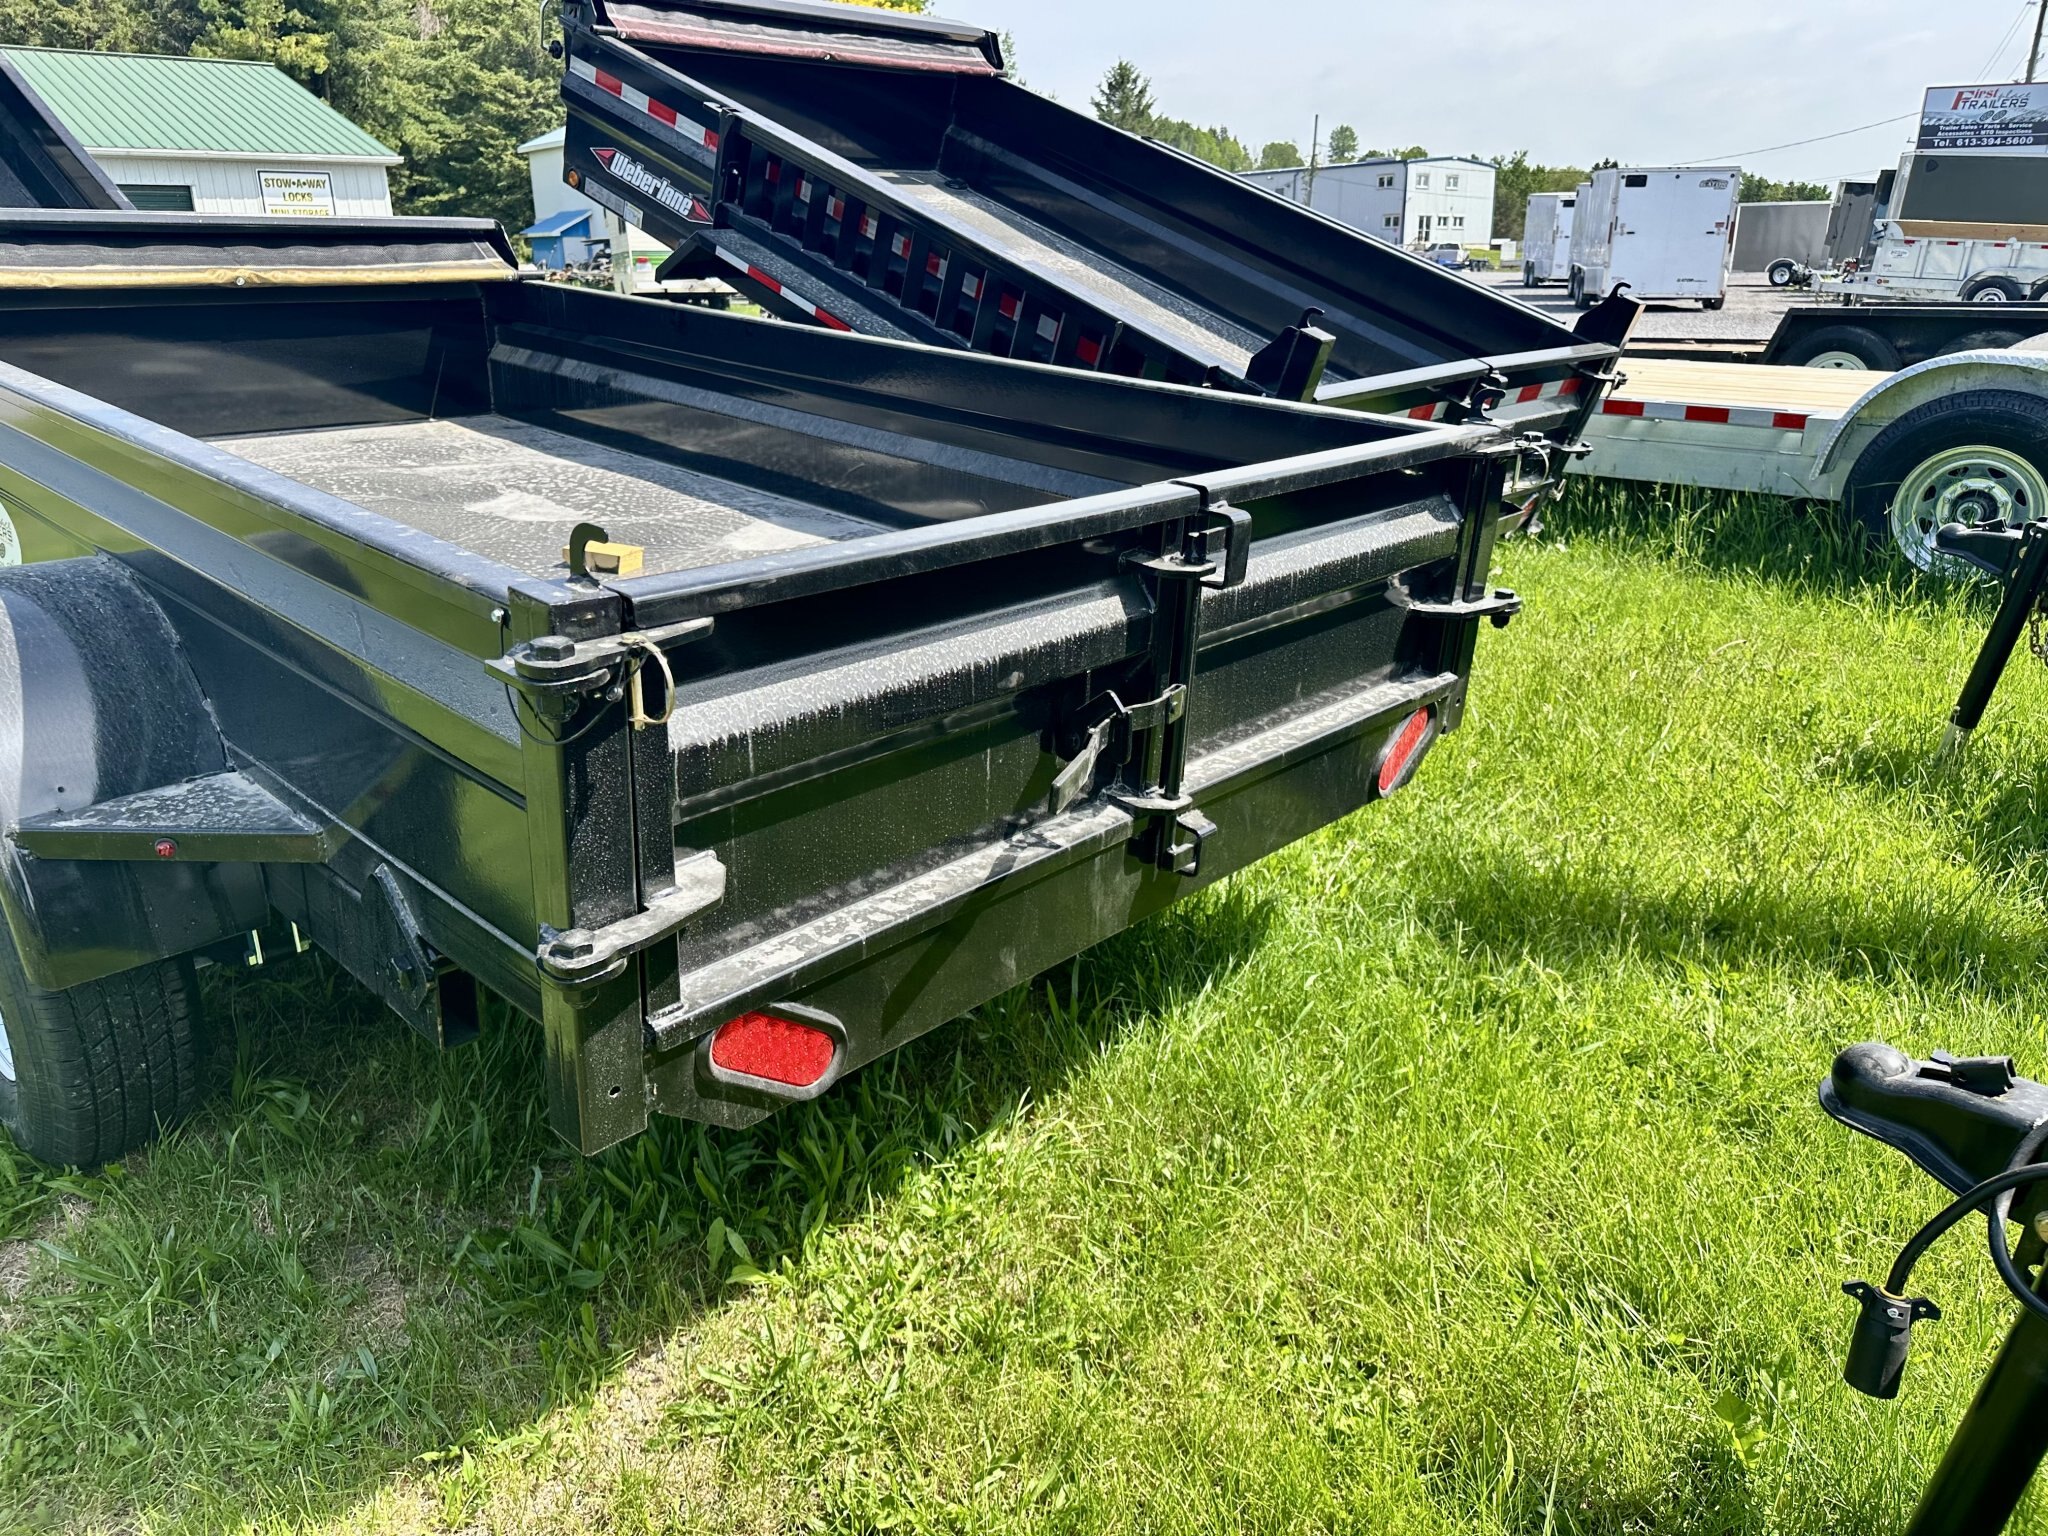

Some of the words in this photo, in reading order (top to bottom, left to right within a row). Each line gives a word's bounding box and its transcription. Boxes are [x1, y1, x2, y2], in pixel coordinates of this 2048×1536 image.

[1951, 88, 2000, 110] First
[1961, 98, 2029, 110] TRAILERS
[1933, 139, 1952, 147] Tel.
[1956, 136, 2034, 146] 613-394-5600
[610, 152, 694, 216] Weberlane
[283, 192, 313, 202] LOCKS
